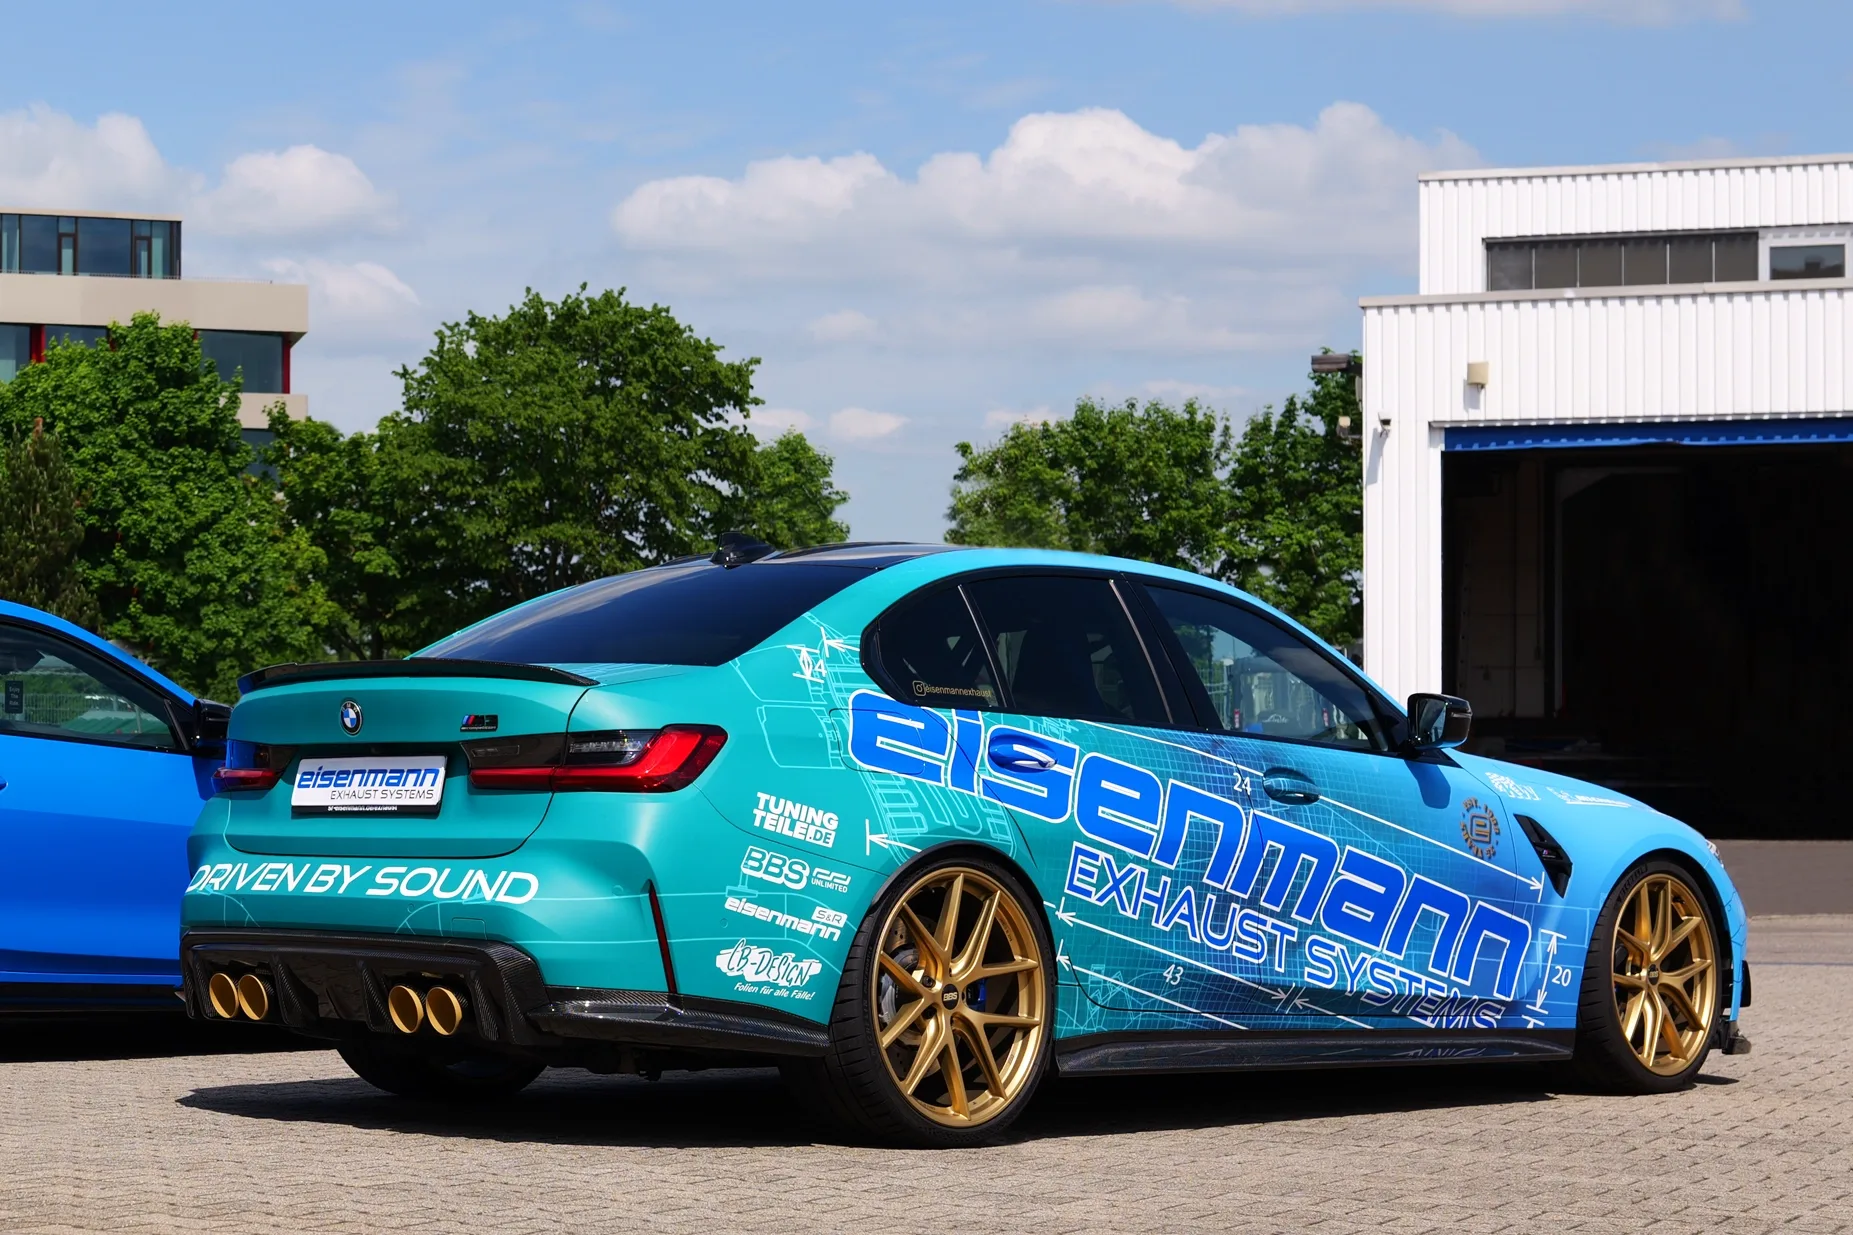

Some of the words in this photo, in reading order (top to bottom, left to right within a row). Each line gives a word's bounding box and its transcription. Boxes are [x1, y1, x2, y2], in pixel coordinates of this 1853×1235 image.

[297, 765, 440, 788] eisenmann
[1233, 773, 1252, 794] 24
[330, 789, 378, 800] EXHAUST
[380, 789, 434, 799] SYSTEMS
[756, 791, 839, 830] TUNING
[848, 689, 1532, 1001] eisenmann
[741, 846, 810, 890] BBS
[185, 863, 312, 893] DRIVEN
[303, 864, 372, 894] BY
[365, 866, 539, 905] SOUND
[811, 877, 849, 893] UNLIMITED
[724, 897, 841, 942] eisenmann
[816, 908, 844, 925] S&R
[1065, 841, 1298, 973] EXHAUST
[1303, 935, 1506, 1029] SYSTEMS
[1162, 966, 1185, 986] 43
[1552, 965, 1572, 987] 20
[734, 982, 758, 993] Folien
[760, 984, 773, 996] für
[774, 986, 789, 998] alle
[790, 988, 815, 1001] Fälle!
[943, 992, 958, 1002] BBS
